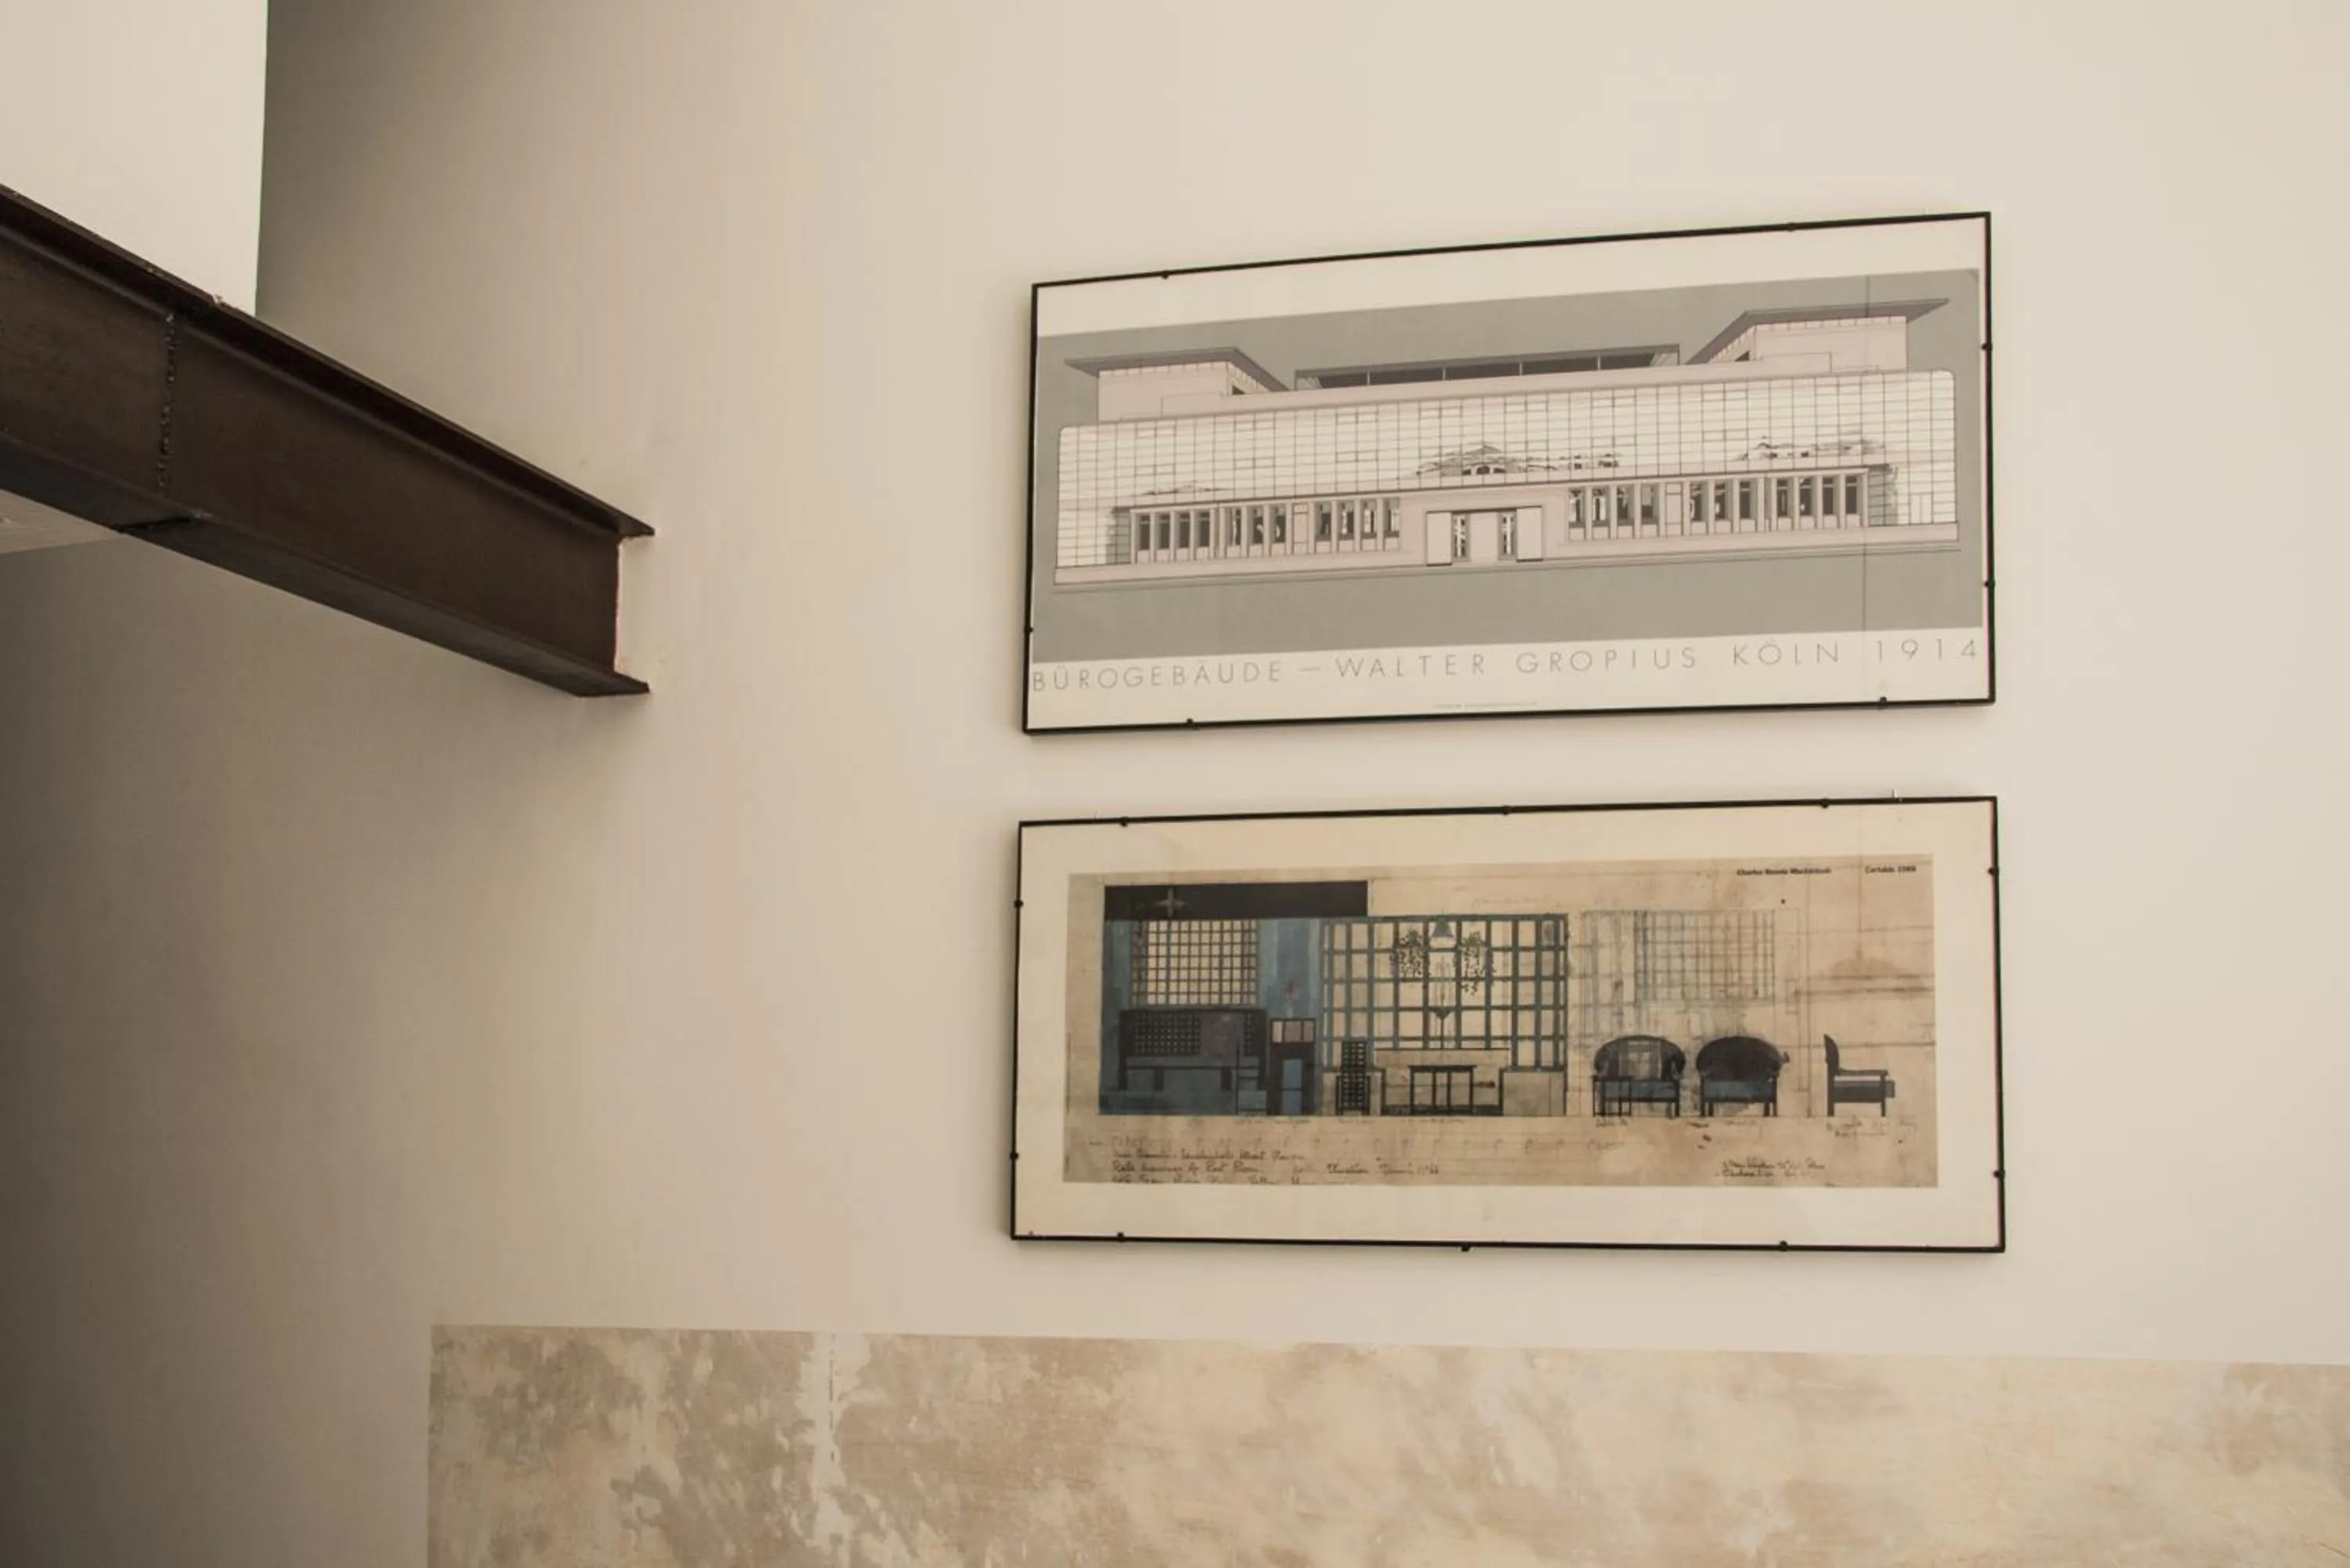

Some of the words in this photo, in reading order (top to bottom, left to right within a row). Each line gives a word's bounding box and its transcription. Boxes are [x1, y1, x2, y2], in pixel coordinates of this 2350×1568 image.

[1032, 659, 1282, 692] BÜROGEBÄUDE
[1335, 652, 1486, 678] WALTER
[1515, 647, 1698, 674] GROPIUS
[1732, 638, 1840, 666] KÖLN
[1875, 638, 1979, 662] 1914
